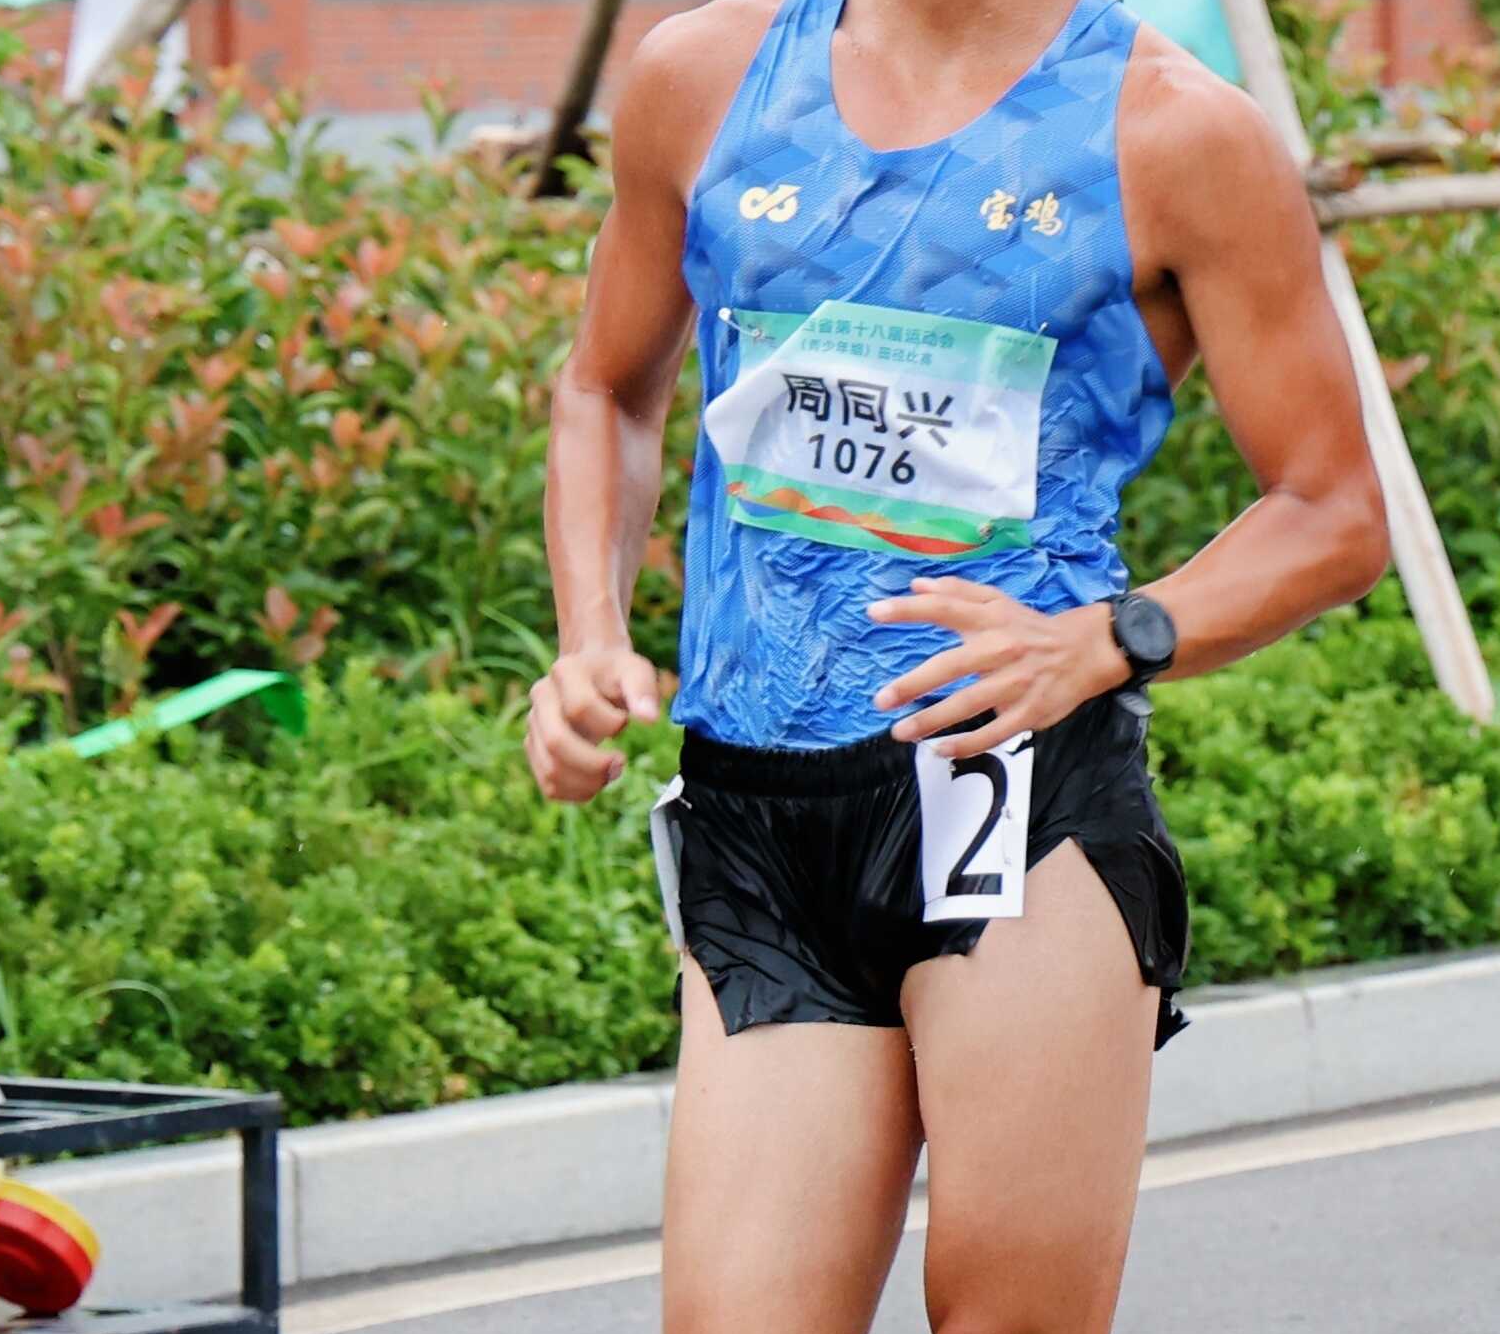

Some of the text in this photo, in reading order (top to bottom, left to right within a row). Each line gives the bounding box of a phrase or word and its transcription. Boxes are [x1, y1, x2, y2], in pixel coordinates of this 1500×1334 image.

[979, 188, 1065, 236] 宝鸡
[782, 373, 954, 449] 周同兴
[808, 433, 916, 485] 1076
[947, 750, 1009, 897] 2
